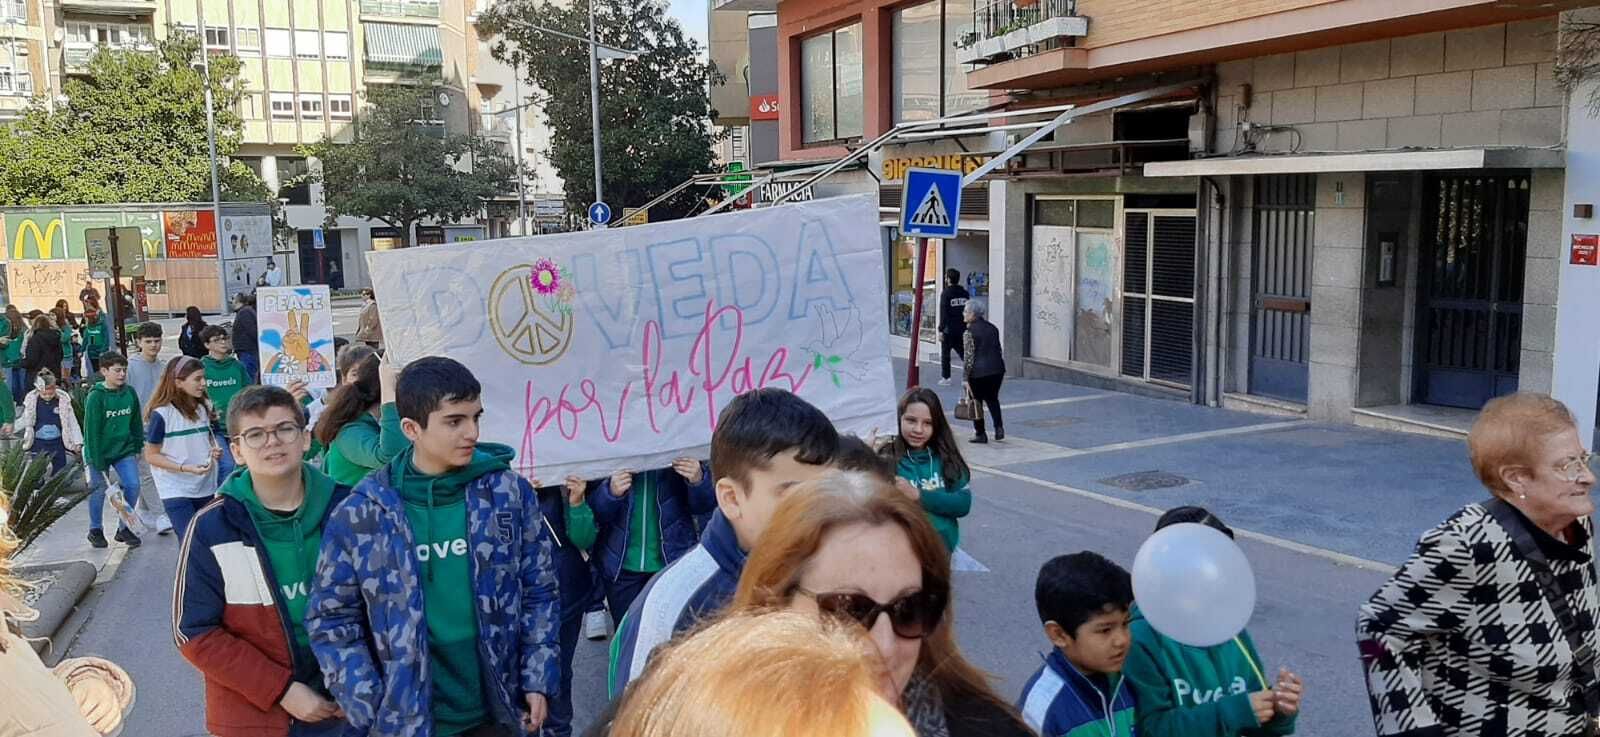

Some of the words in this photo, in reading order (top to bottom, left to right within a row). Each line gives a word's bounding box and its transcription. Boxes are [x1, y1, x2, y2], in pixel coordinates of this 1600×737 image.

[760, 183, 814, 201] FARMACIA
[263, 295, 323, 313] PEACE
[519, 379, 633, 481] por
[641, 319, 696, 434] la
[689, 298, 813, 434] Paz
[415, 538, 468, 562] ove
